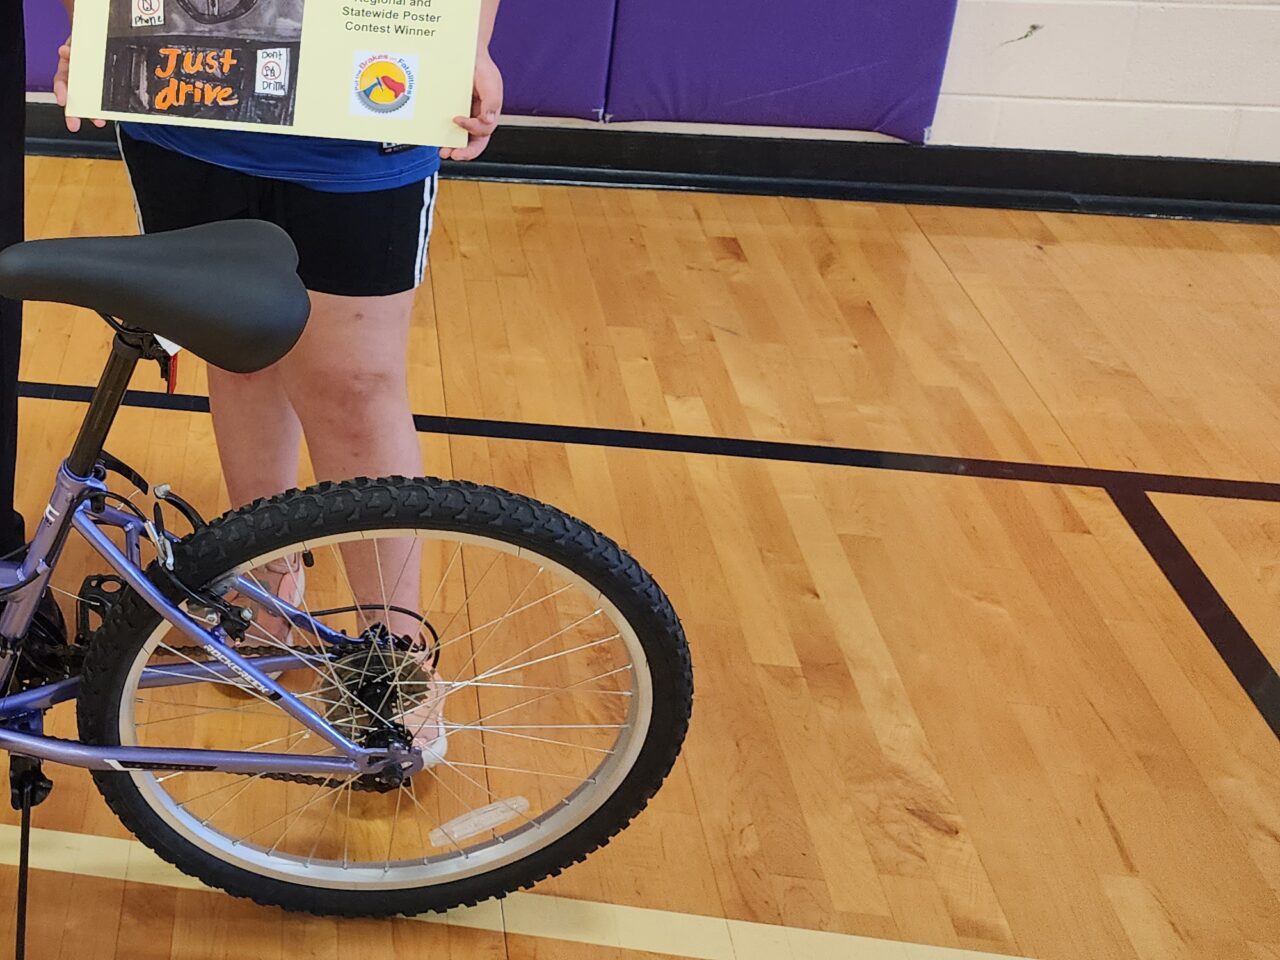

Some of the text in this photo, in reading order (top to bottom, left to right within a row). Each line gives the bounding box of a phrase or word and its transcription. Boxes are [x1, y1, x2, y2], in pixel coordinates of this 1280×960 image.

[342, 6, 441, 23] Statewide Poster
[345, 21, 436, 37] Contest Winner
[154, 48, 238, 78] Just
[397, 58, 414, 95] Fatalities
[154, 78, 240, 110] drive
